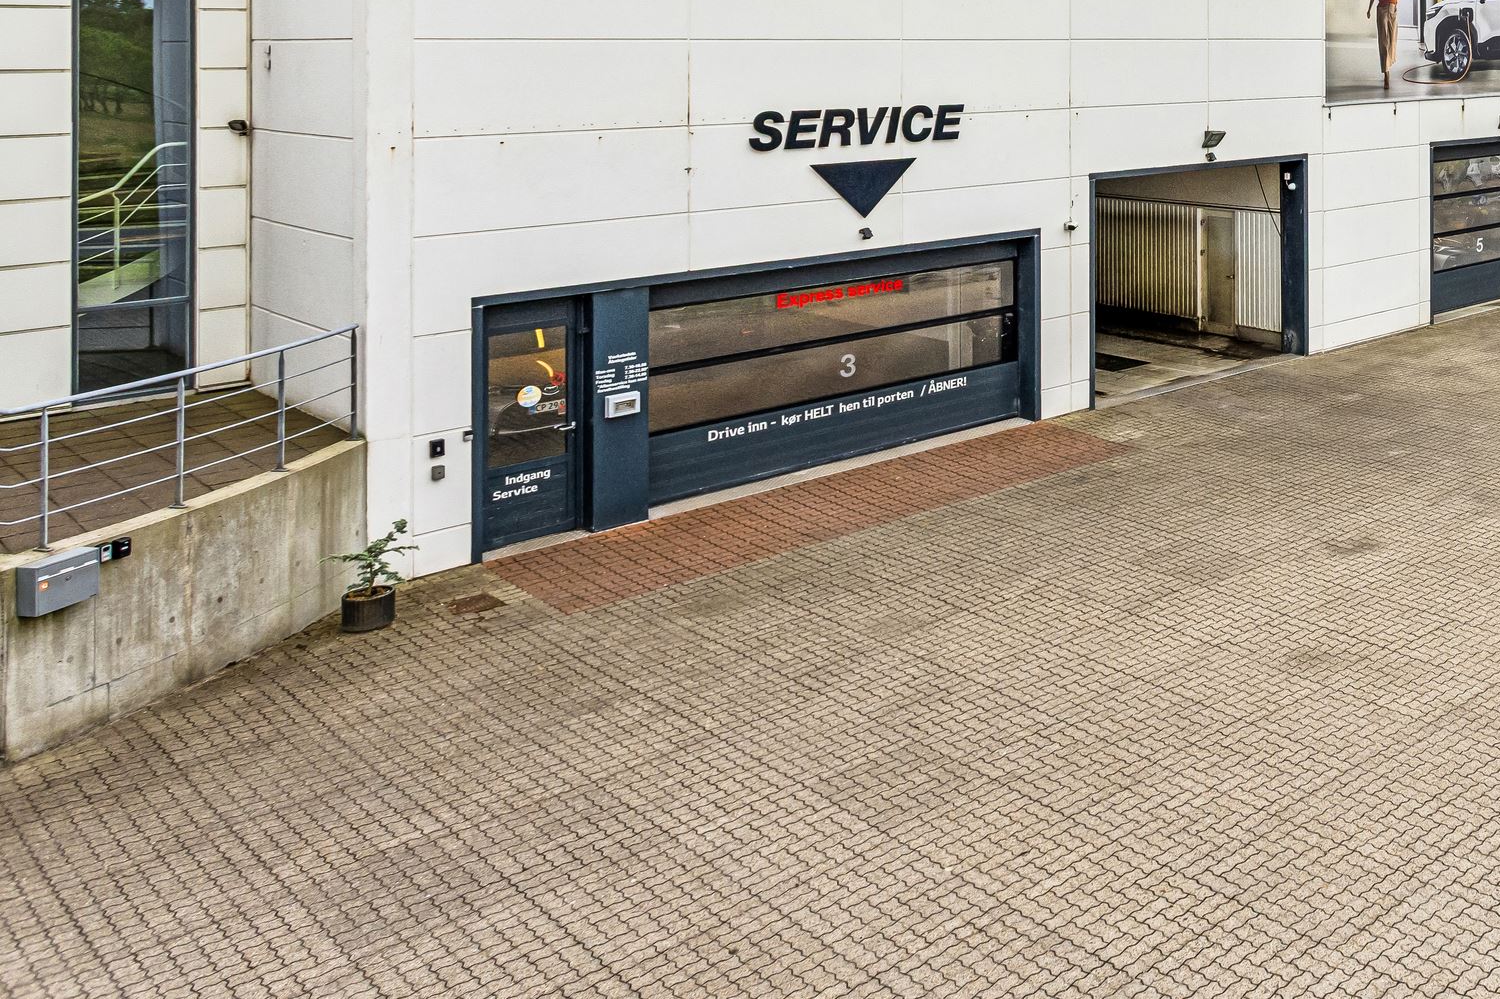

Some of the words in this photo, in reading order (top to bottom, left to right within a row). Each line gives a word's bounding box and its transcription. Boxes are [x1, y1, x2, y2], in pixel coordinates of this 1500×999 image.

[748, 103, 965, 151] SERVICE
[1476, 237, 1484, 253] 5
[776, 287, 844, 309] Express
[847, 279, 904, 298] service
[839, 353, 857, 378] 3
[707, 426, 746, 442] Drive
[747, 421, 768, 433] inn
[781, 414, 803, 426] kør
[804, 405, 835, 421] HELT
[839, 401, 861, 414] hen
[862, 396, 876, 408] til
[877, 390, 914, 407] porten
[505, 469, 551, 486] Indgang
[492, 484, 538, 501] Service
